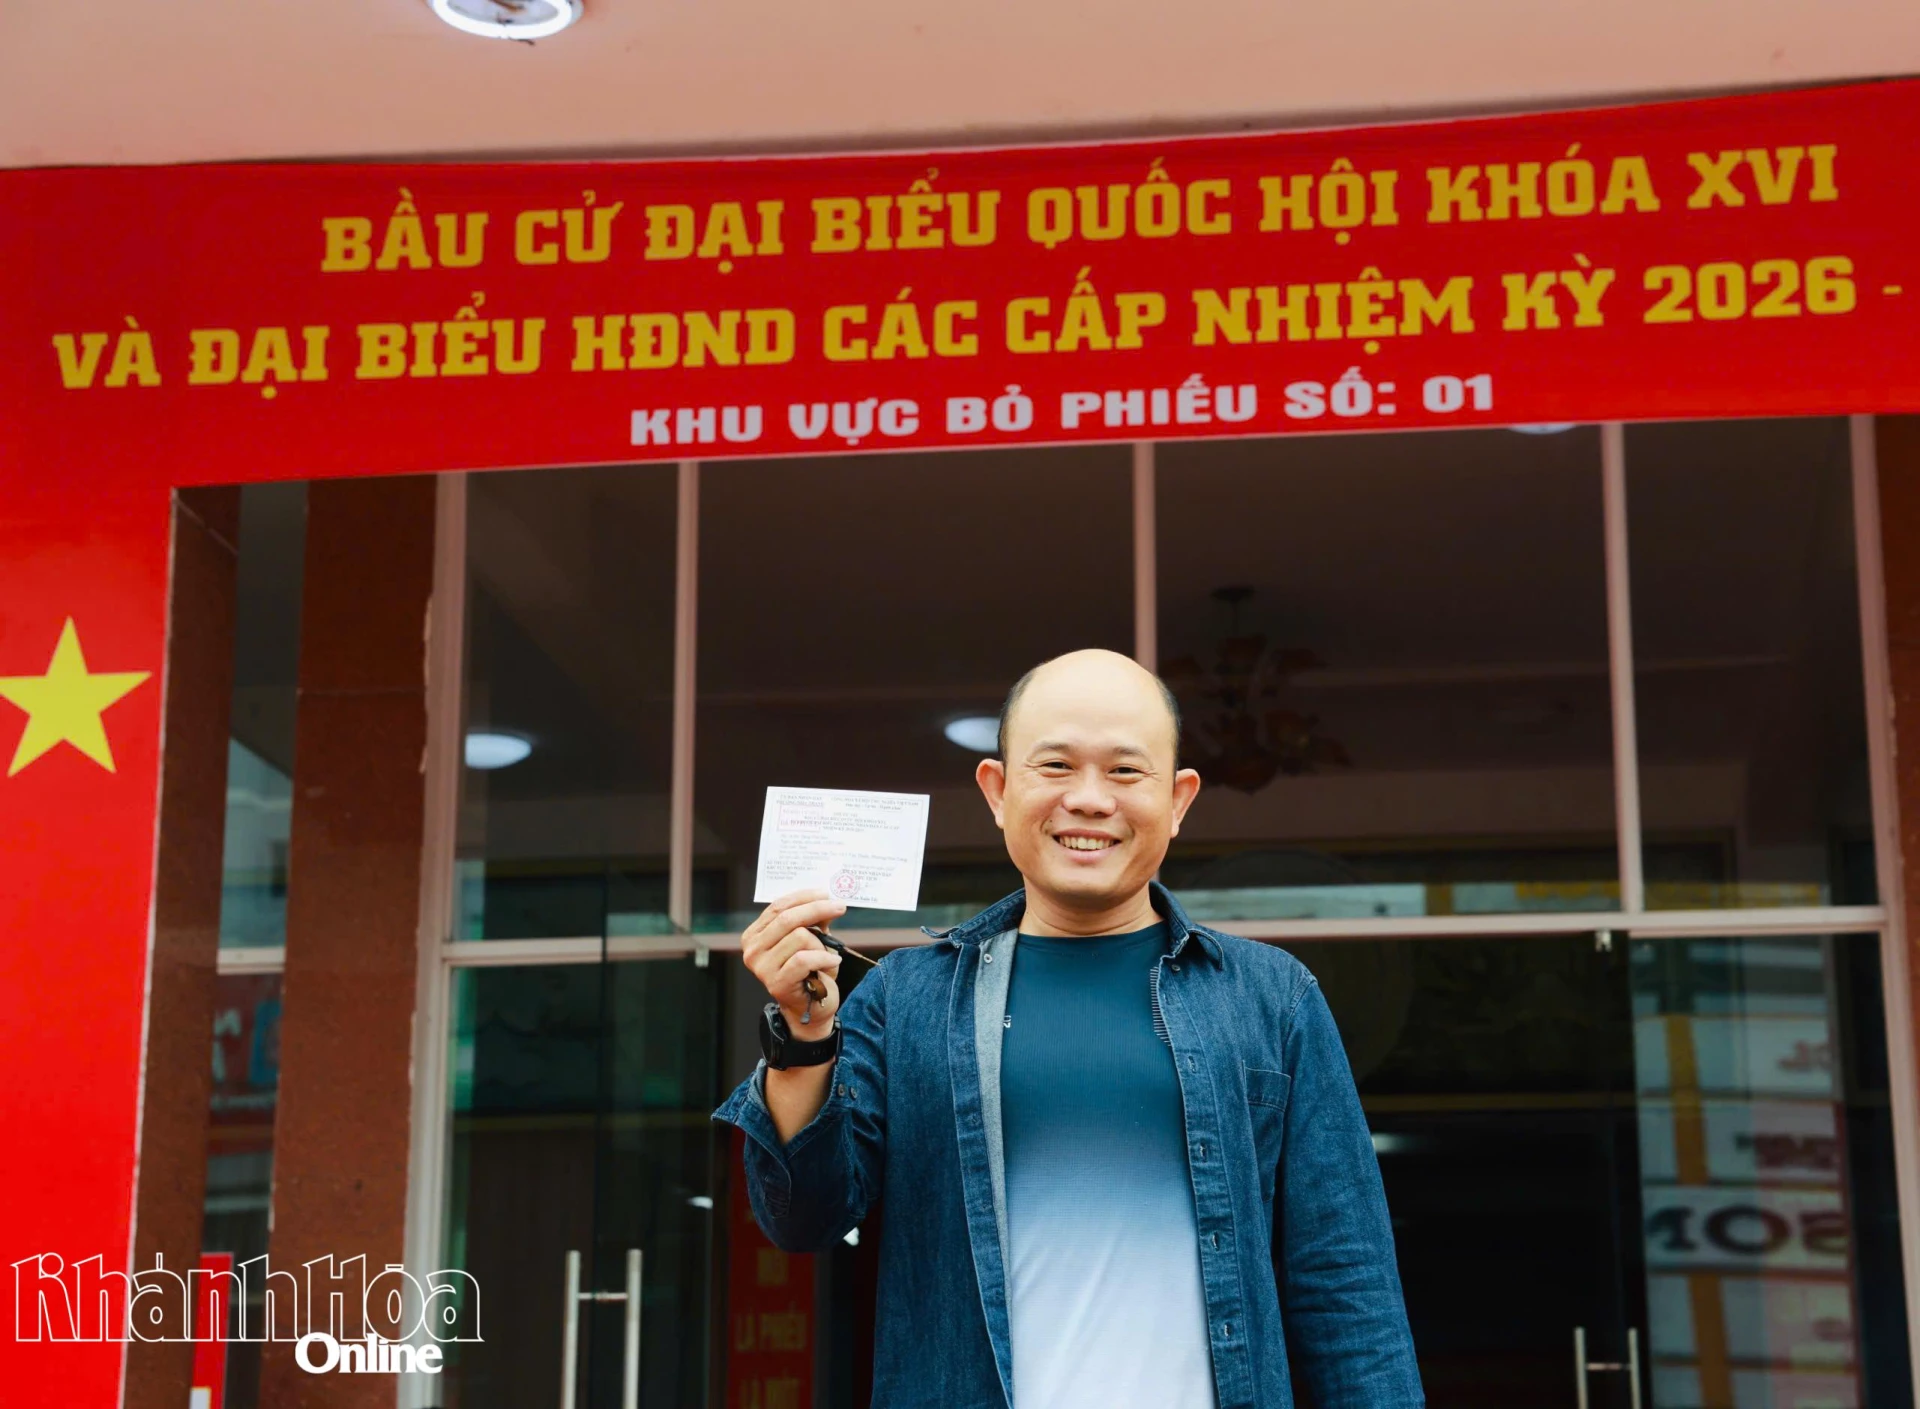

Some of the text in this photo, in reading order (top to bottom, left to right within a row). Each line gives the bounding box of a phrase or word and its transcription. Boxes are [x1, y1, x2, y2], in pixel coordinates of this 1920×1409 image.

[321, 143, 1838, 274] BẦU CỬ ĐẠI BIỂU QUỐC HỘI KHÓA XVI
[52, 315, 161, 389] VÀ
[188, 325, 330, 399] ĐẠI
[355, 291, 546, 379] BIỂU
[571, 308, 795, 372] HĐND
[823, 287, 979, 361] CÁC
[1006, 266, 1166, 354] CẤP
[1192, 267, 1474, 355] NHIỆM
[1501, 253, 1615, 331] KỲ
[1643, 256, 1856, 324] 2026
[630, 366, 1493, 446] KHU VỰC BỎ PHIẾU SỐ: 01
